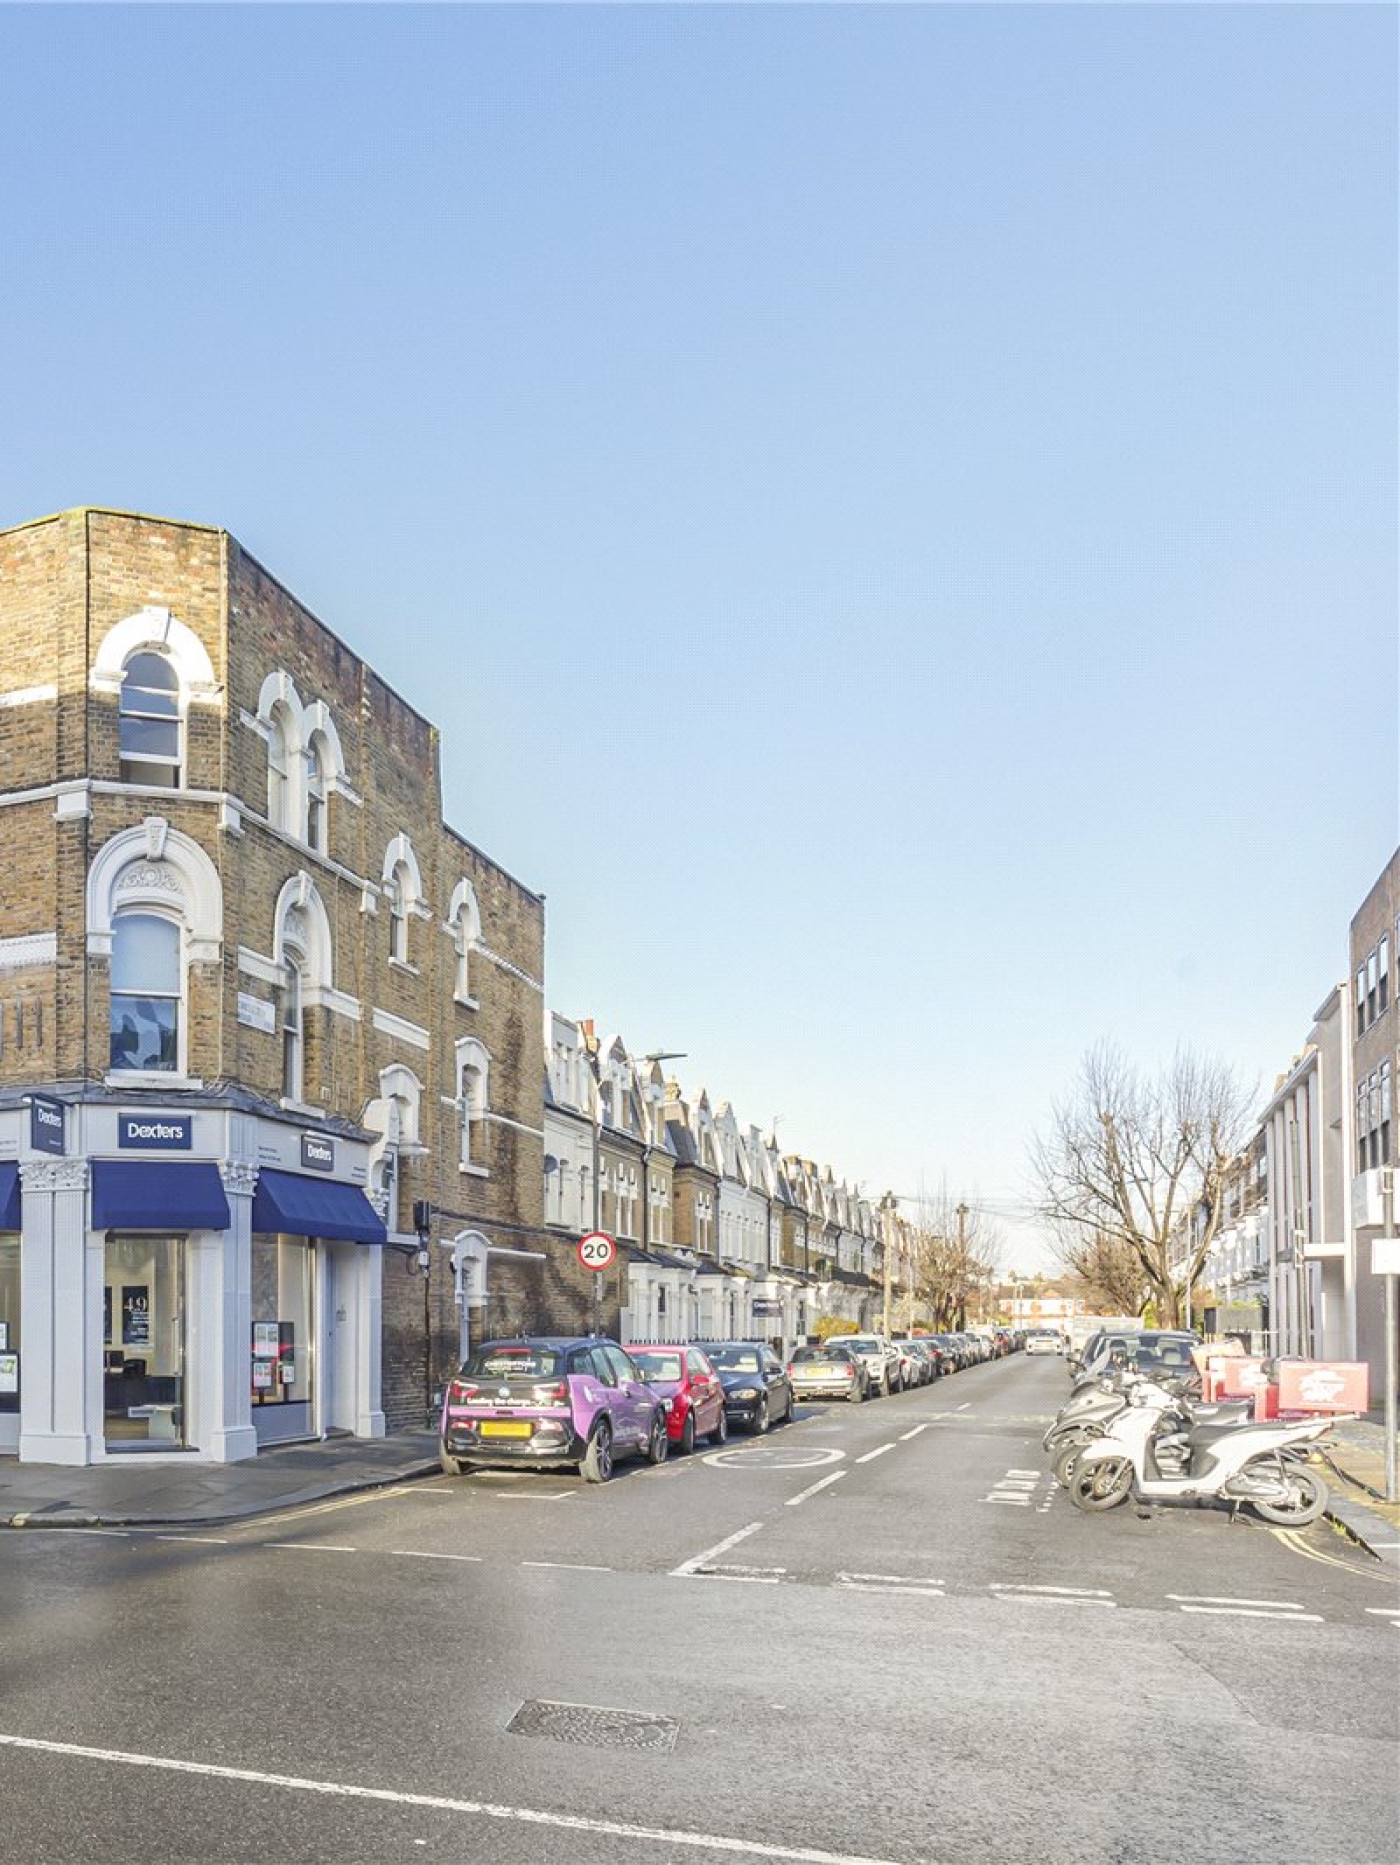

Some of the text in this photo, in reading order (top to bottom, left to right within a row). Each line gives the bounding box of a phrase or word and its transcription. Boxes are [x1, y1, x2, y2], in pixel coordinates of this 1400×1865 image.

[38, 1108, 62, 1128] Dexters
[127, 1122, 183, 1139] Dexters
[584, 1243, 609, 1258] 20
